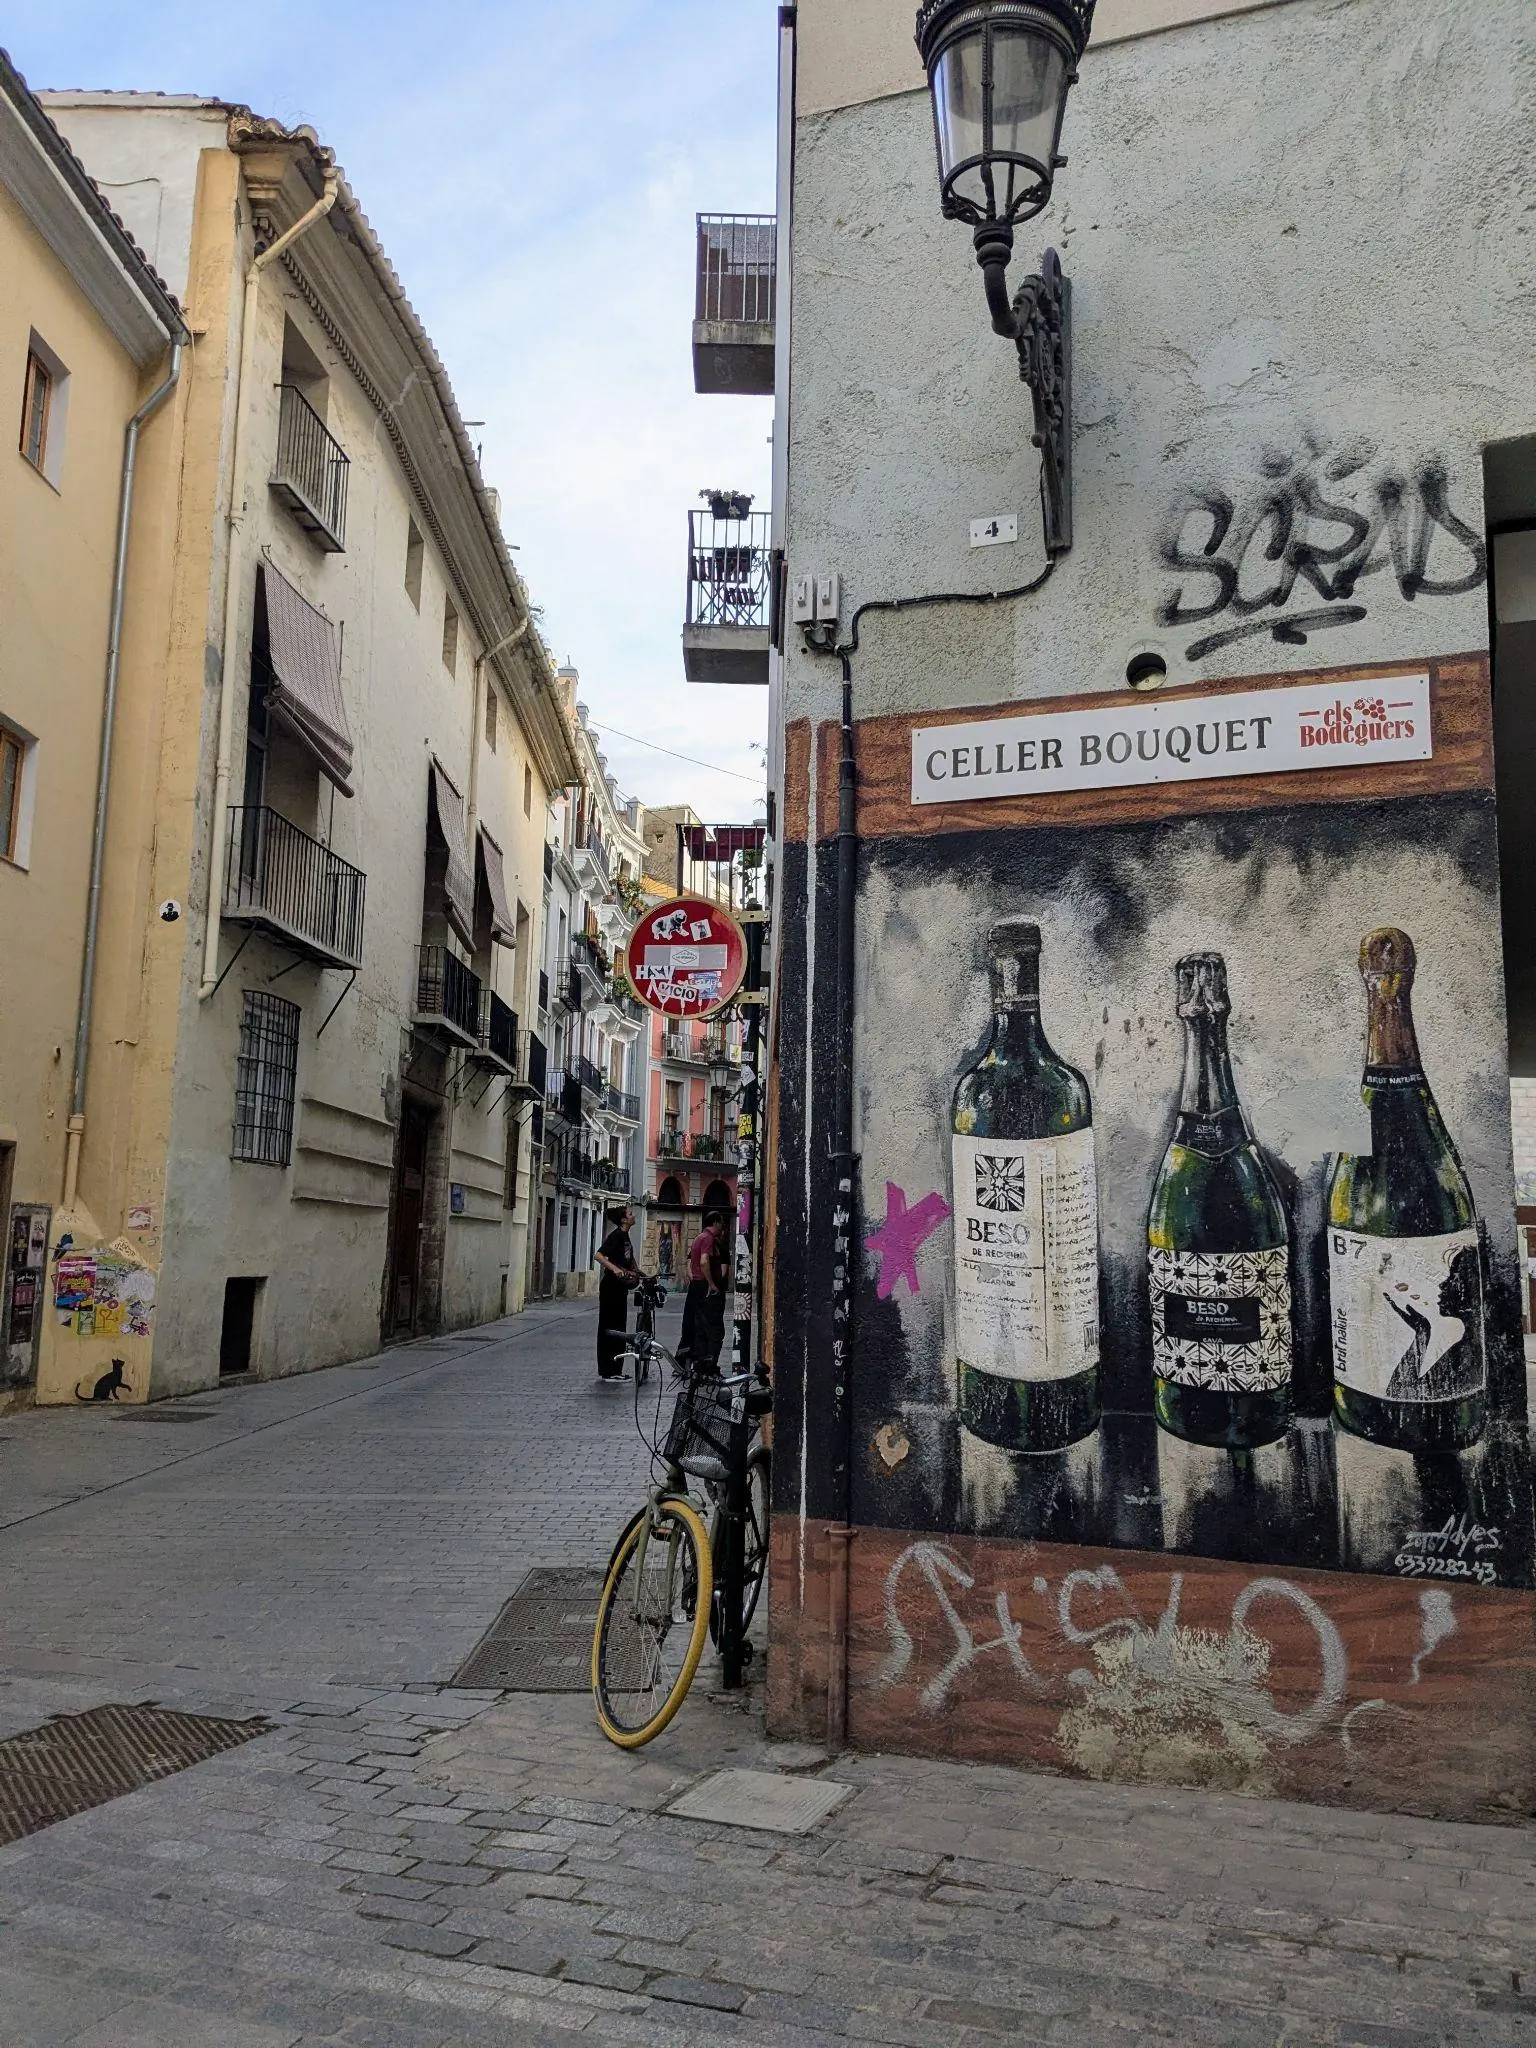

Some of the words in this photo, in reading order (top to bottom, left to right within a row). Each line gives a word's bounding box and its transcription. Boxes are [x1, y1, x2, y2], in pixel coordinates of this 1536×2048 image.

[984, 521, 999, 538] 4
[1323, 700, 1353, 726] els
[1299, 719, 1415, 748] Bodeguers
[925, 737, 1064, 781] CELLER
[1079, 716, 1272, 767] BOUQUET
[1366, 1075, 1388, 1084] BRUT
[966, 1217, 1030, 1245] BESO
[1186, 1300, 1229, 1315] BESO
